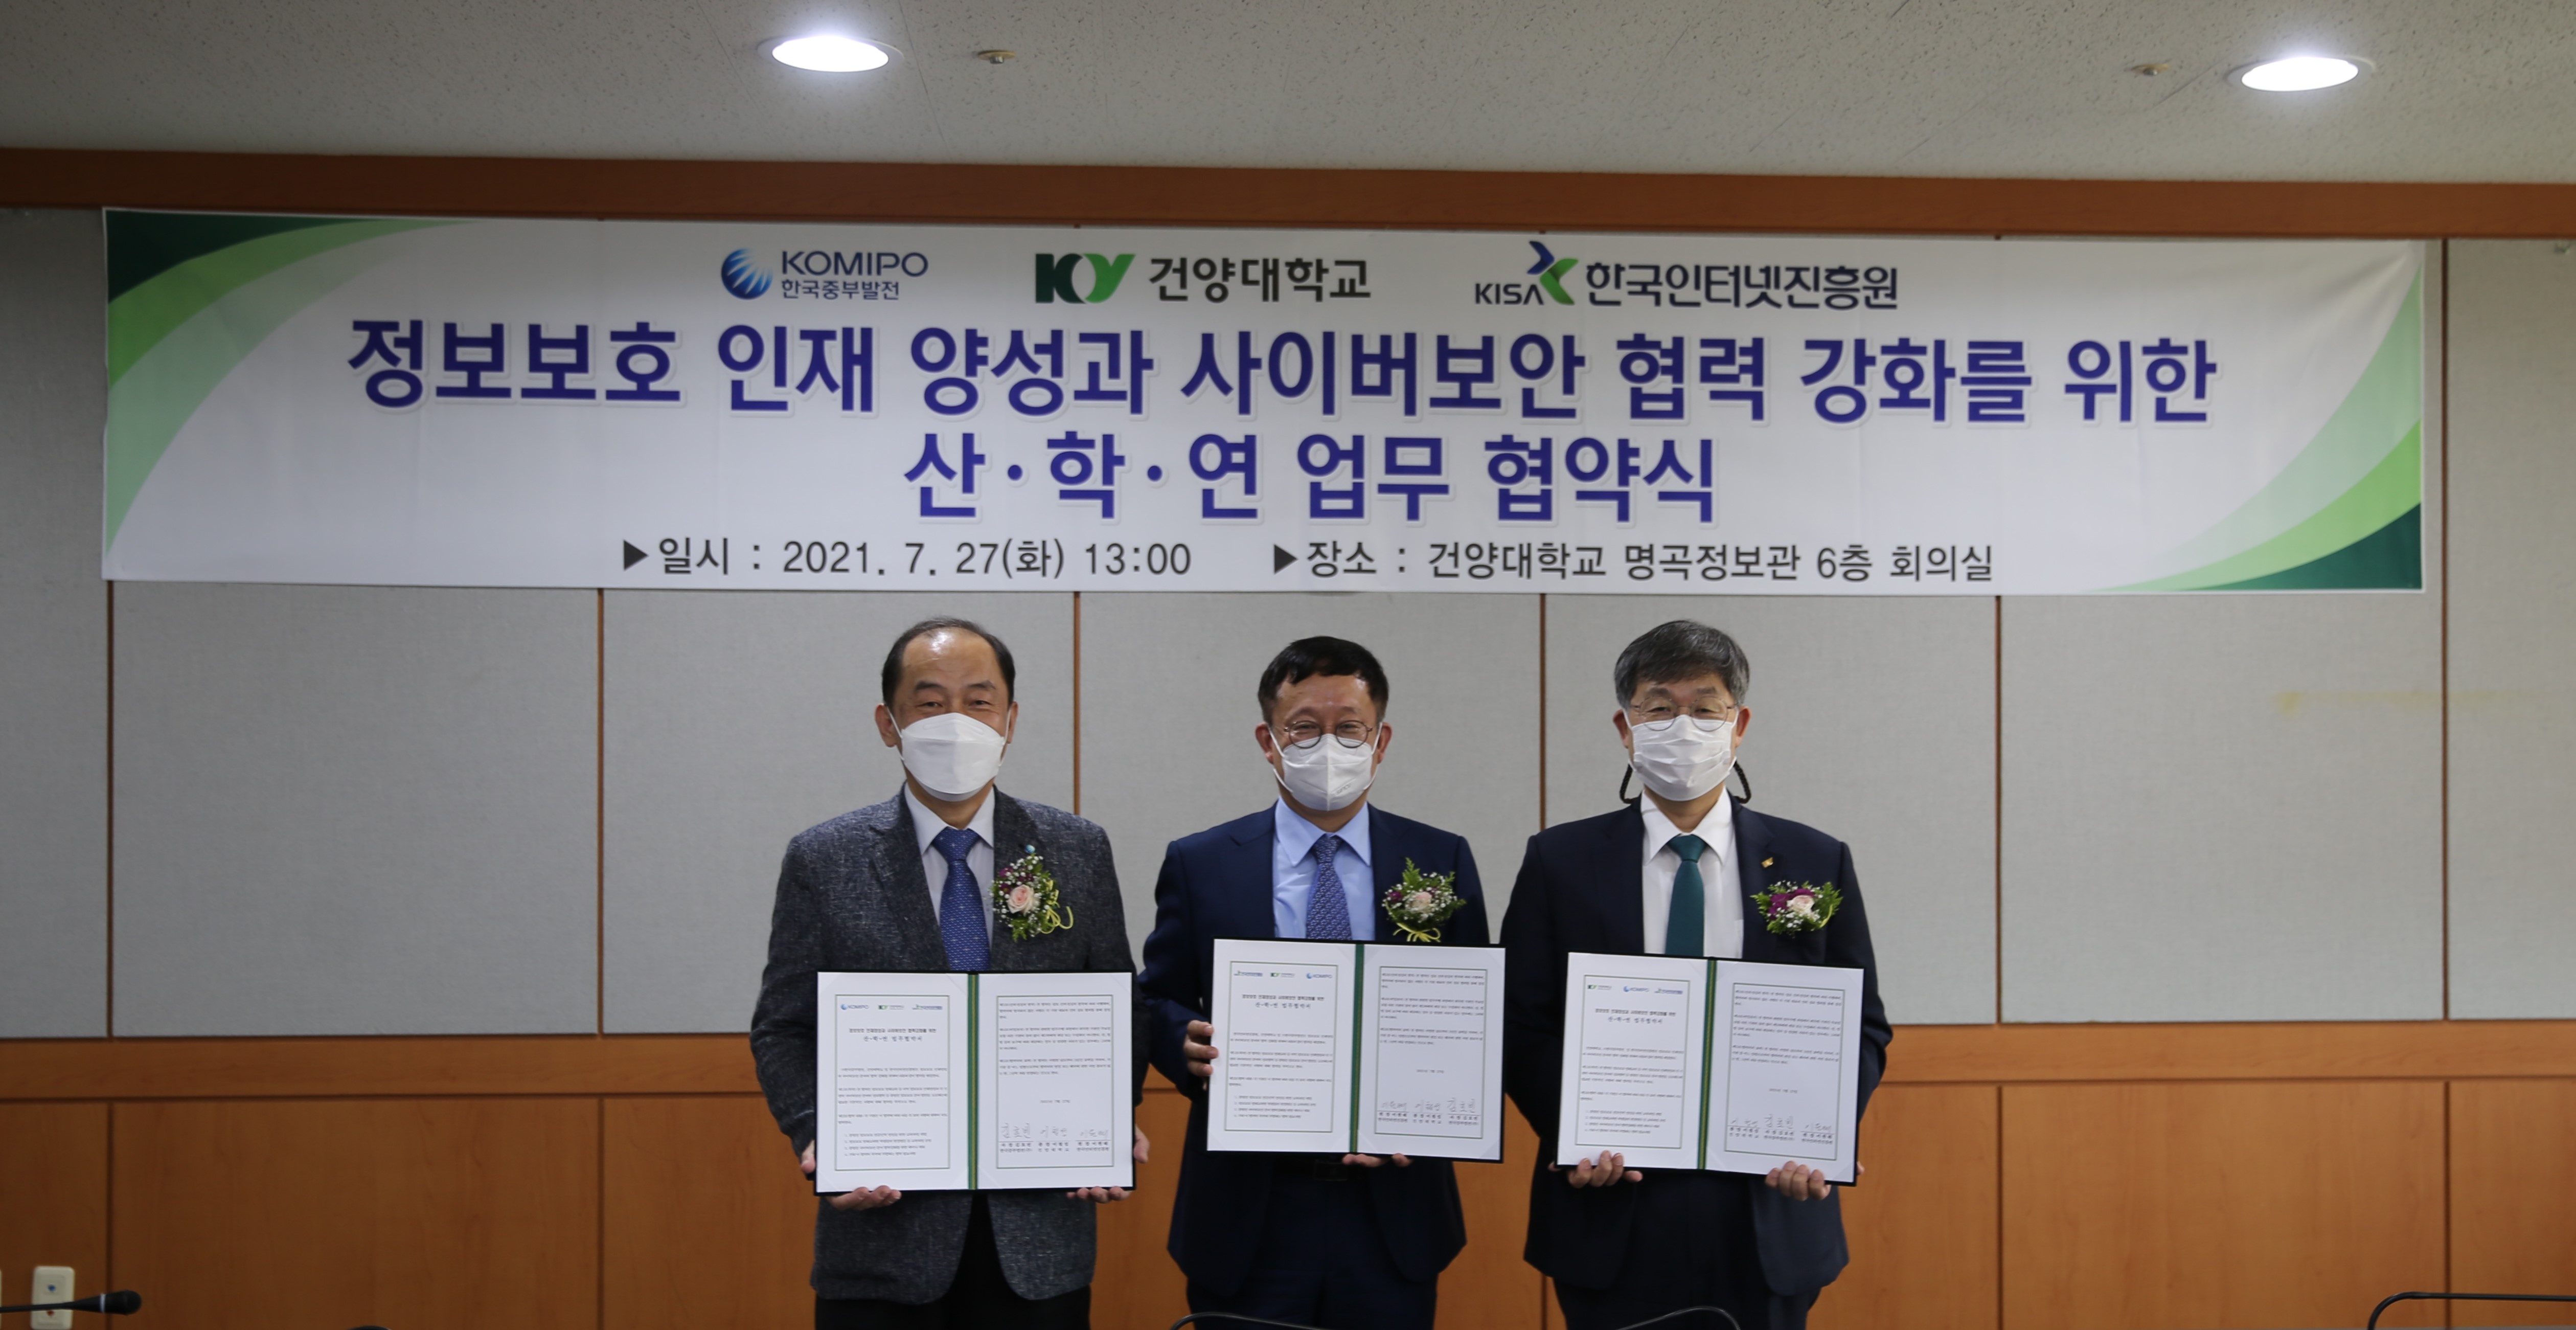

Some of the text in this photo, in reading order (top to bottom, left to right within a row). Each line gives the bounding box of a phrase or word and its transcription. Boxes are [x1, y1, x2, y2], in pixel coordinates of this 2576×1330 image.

[782, 250, 929, 278] KOMIPO
[1148, 256, 1372, 304] 건양대학교
[781, 278, 899, 300] 한국중부발전
[1475, 282, 1544, 306] KISA
[1586, 261, 1898, 310] 한국인터넷진흥원
[348, 319, 2217, 423] 정보보호 인재 양성과 사이버보안 협력 강화를 위한
[1296, 433, 1450, 522] 업무
[1484, 434, 1713, 523] 협약식
[658, 537, 728, 575] 일시
[783, 541, 885, 576] 2021.
[905, 543, 936, 576] 7.
[956, 538, 1064, 579] 27(화)
[1085, 542, 1191, 575] 13:00
[1306, 540, 1377, 578] 장소
[1428, 542, 1607, 580] 건양대학교
[1625, 543, 1801, 581] 명곡정보관
[1817, 544, 1873, 582] 6층
[1890, 545, 1992, 582] 회의실
